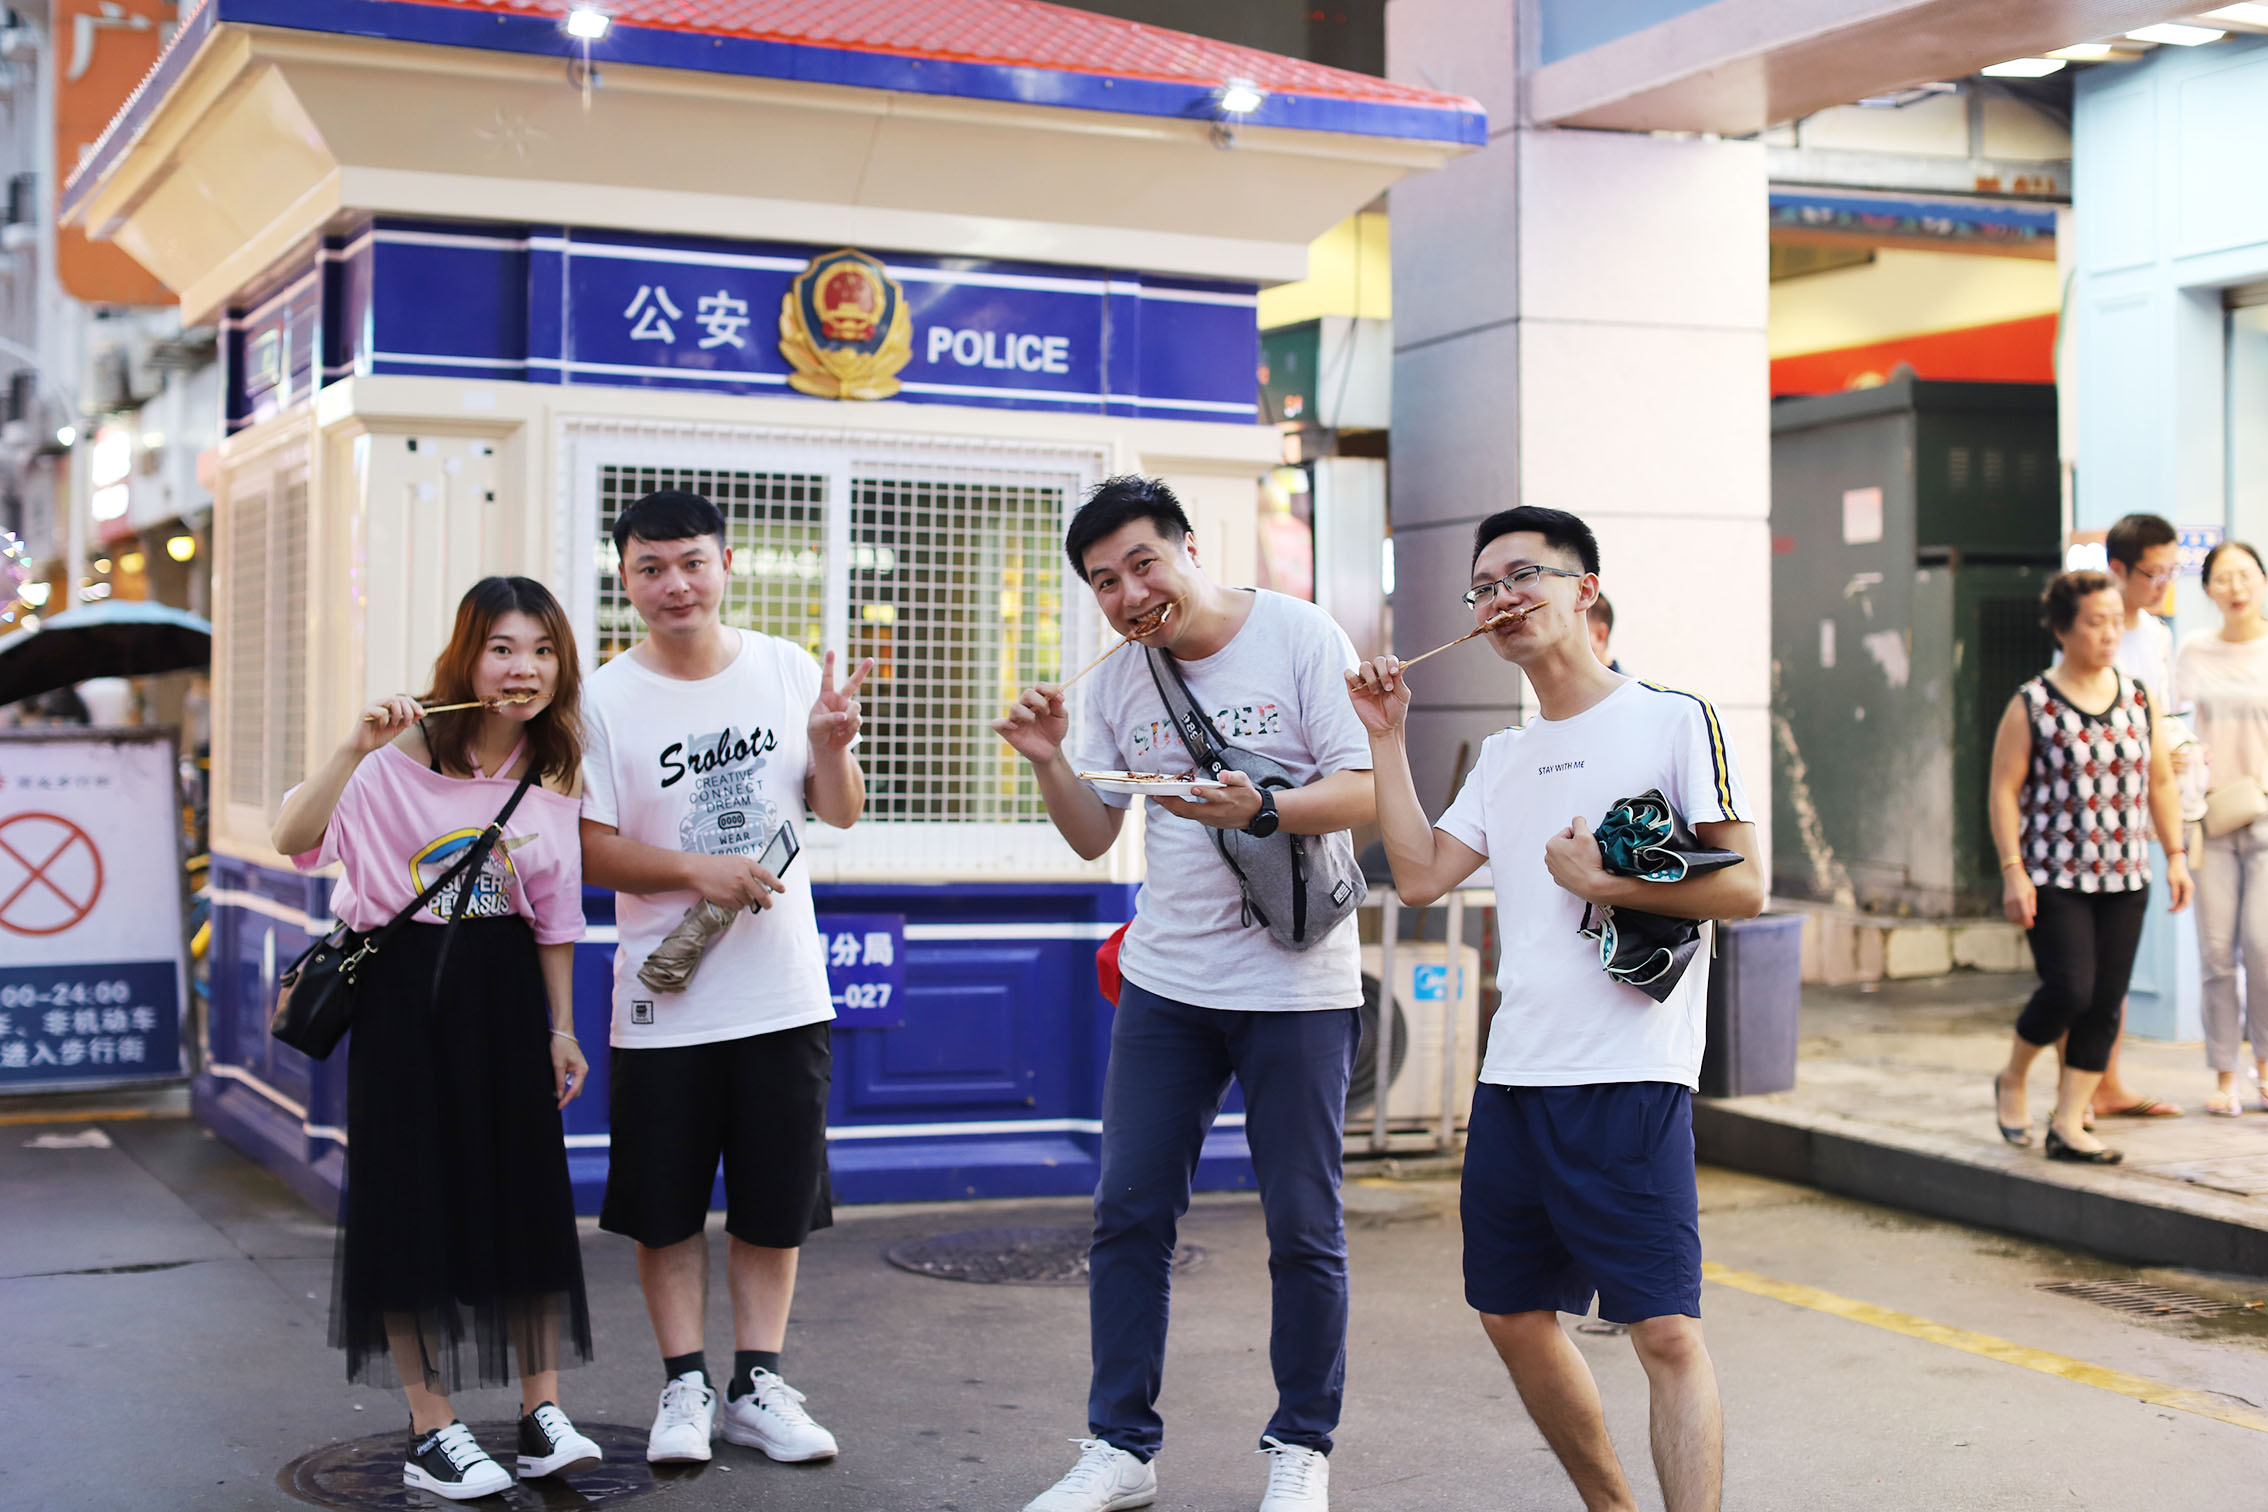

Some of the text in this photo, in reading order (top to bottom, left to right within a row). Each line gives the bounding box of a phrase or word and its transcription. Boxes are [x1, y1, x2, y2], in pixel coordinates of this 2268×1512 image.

[623, 285, 751, 349] 公安
[926, 325, 1070, 375] POLICE
[660, 726, 778, 788] Srobots
[1538, 760, 1585, 776] STAY WITH ME
[695, 768, 754, 790] CREATIVE
[689, 780, 763, 804] CONNECT
[706, 795, 752, 813] DREAM
[719, 831, 751, 846] WEAR
[427, 893, 511, 916] PEASUS
[819, 932, 894, 967] 分局
